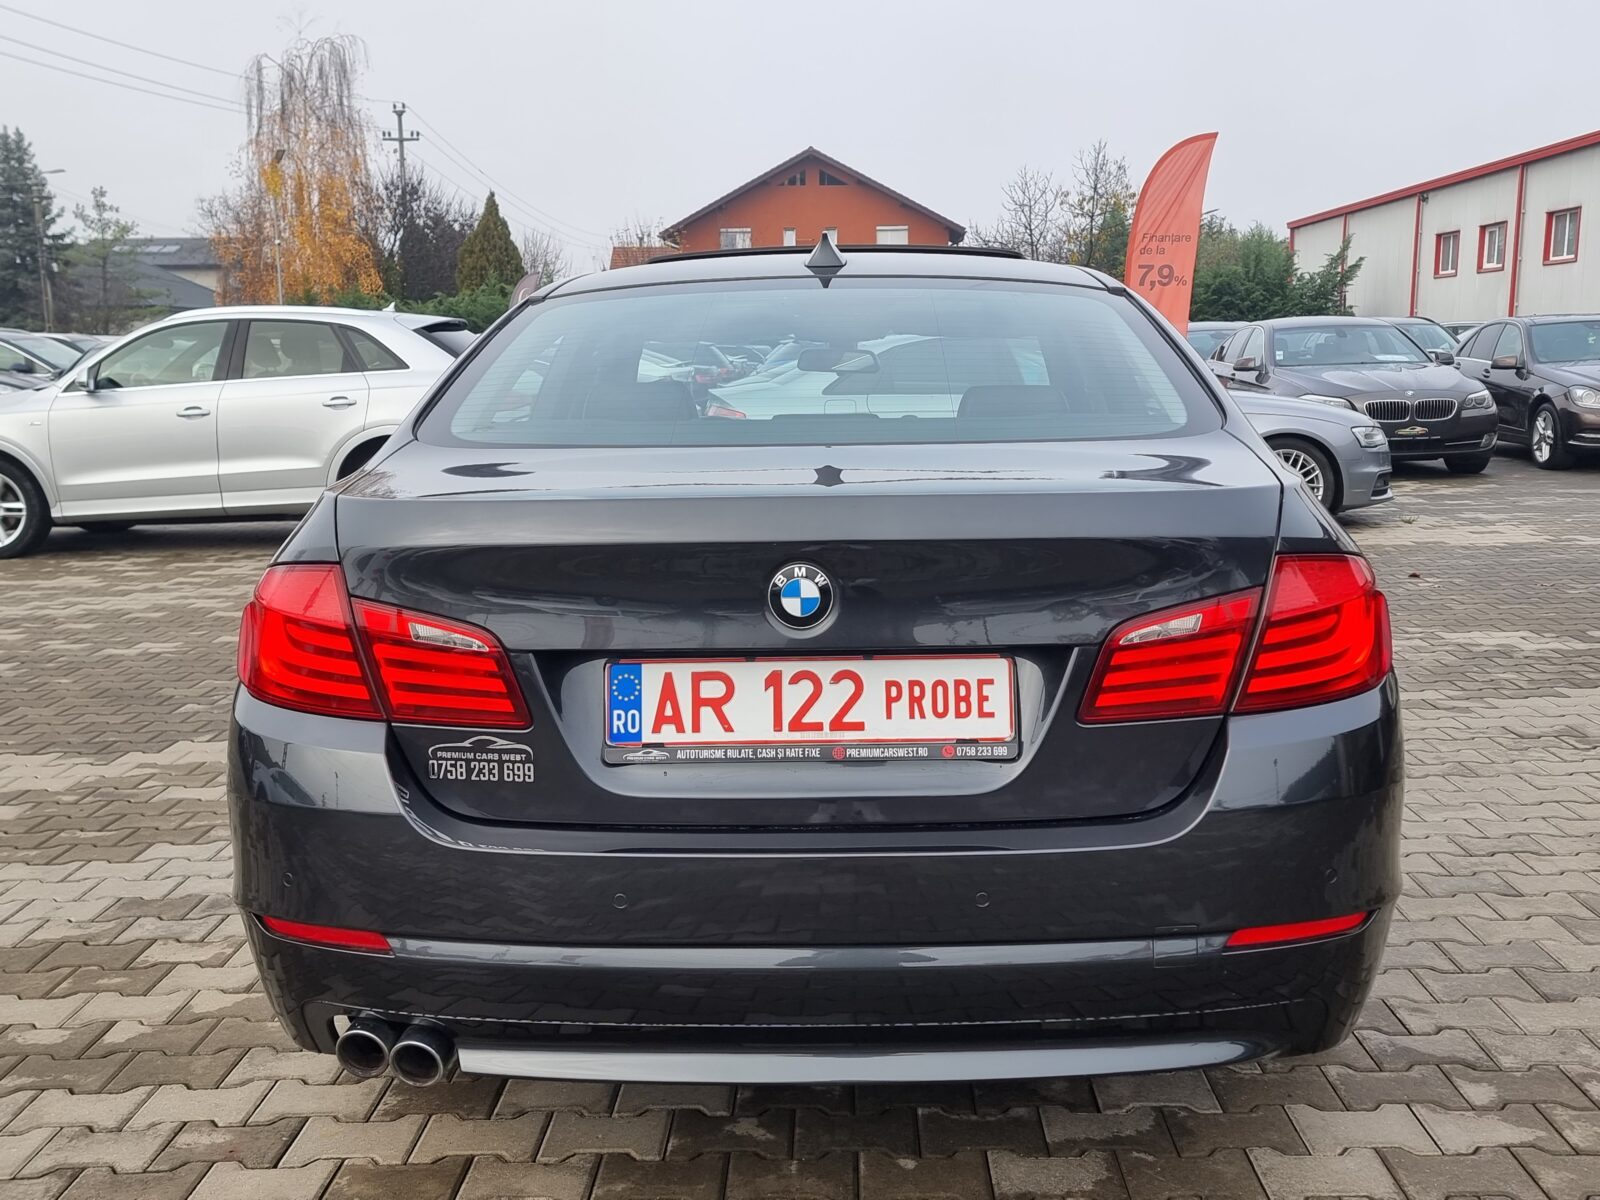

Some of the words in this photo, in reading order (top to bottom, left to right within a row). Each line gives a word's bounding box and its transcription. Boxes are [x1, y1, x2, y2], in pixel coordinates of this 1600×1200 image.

[1139, 246, 1153, 255] de
[1156, 246, 1166, 255] la
[774, 566, 828, 588] BMW
[651, 671, 735, 733] AR
[764, 669, 865, 732] 122
[885, 678, 996, 719] PROBE
[612, 709, 640, 734] RO
[437, 751, 475, 759] PREMIUM
[676, 749, 726, 759] AUTOTURISME
[727, 748, 756, 759] RULATE,
[757, 748, 776, 758] CASH
[785, 748, 804, 758] RATE
[804, 747, 821, 758] FIXE
[846, 747, 929, 758] PREMIUMCARSWEST.RO
[956, 746, 976, 756] 0758
[977, 746, 992, 756] 233
[993, 746, 1008, 756] 699
[428, 760, 466, 780] 0758
[471, 762, 499, 782] 233
[503, 763, 535, 783] 699
